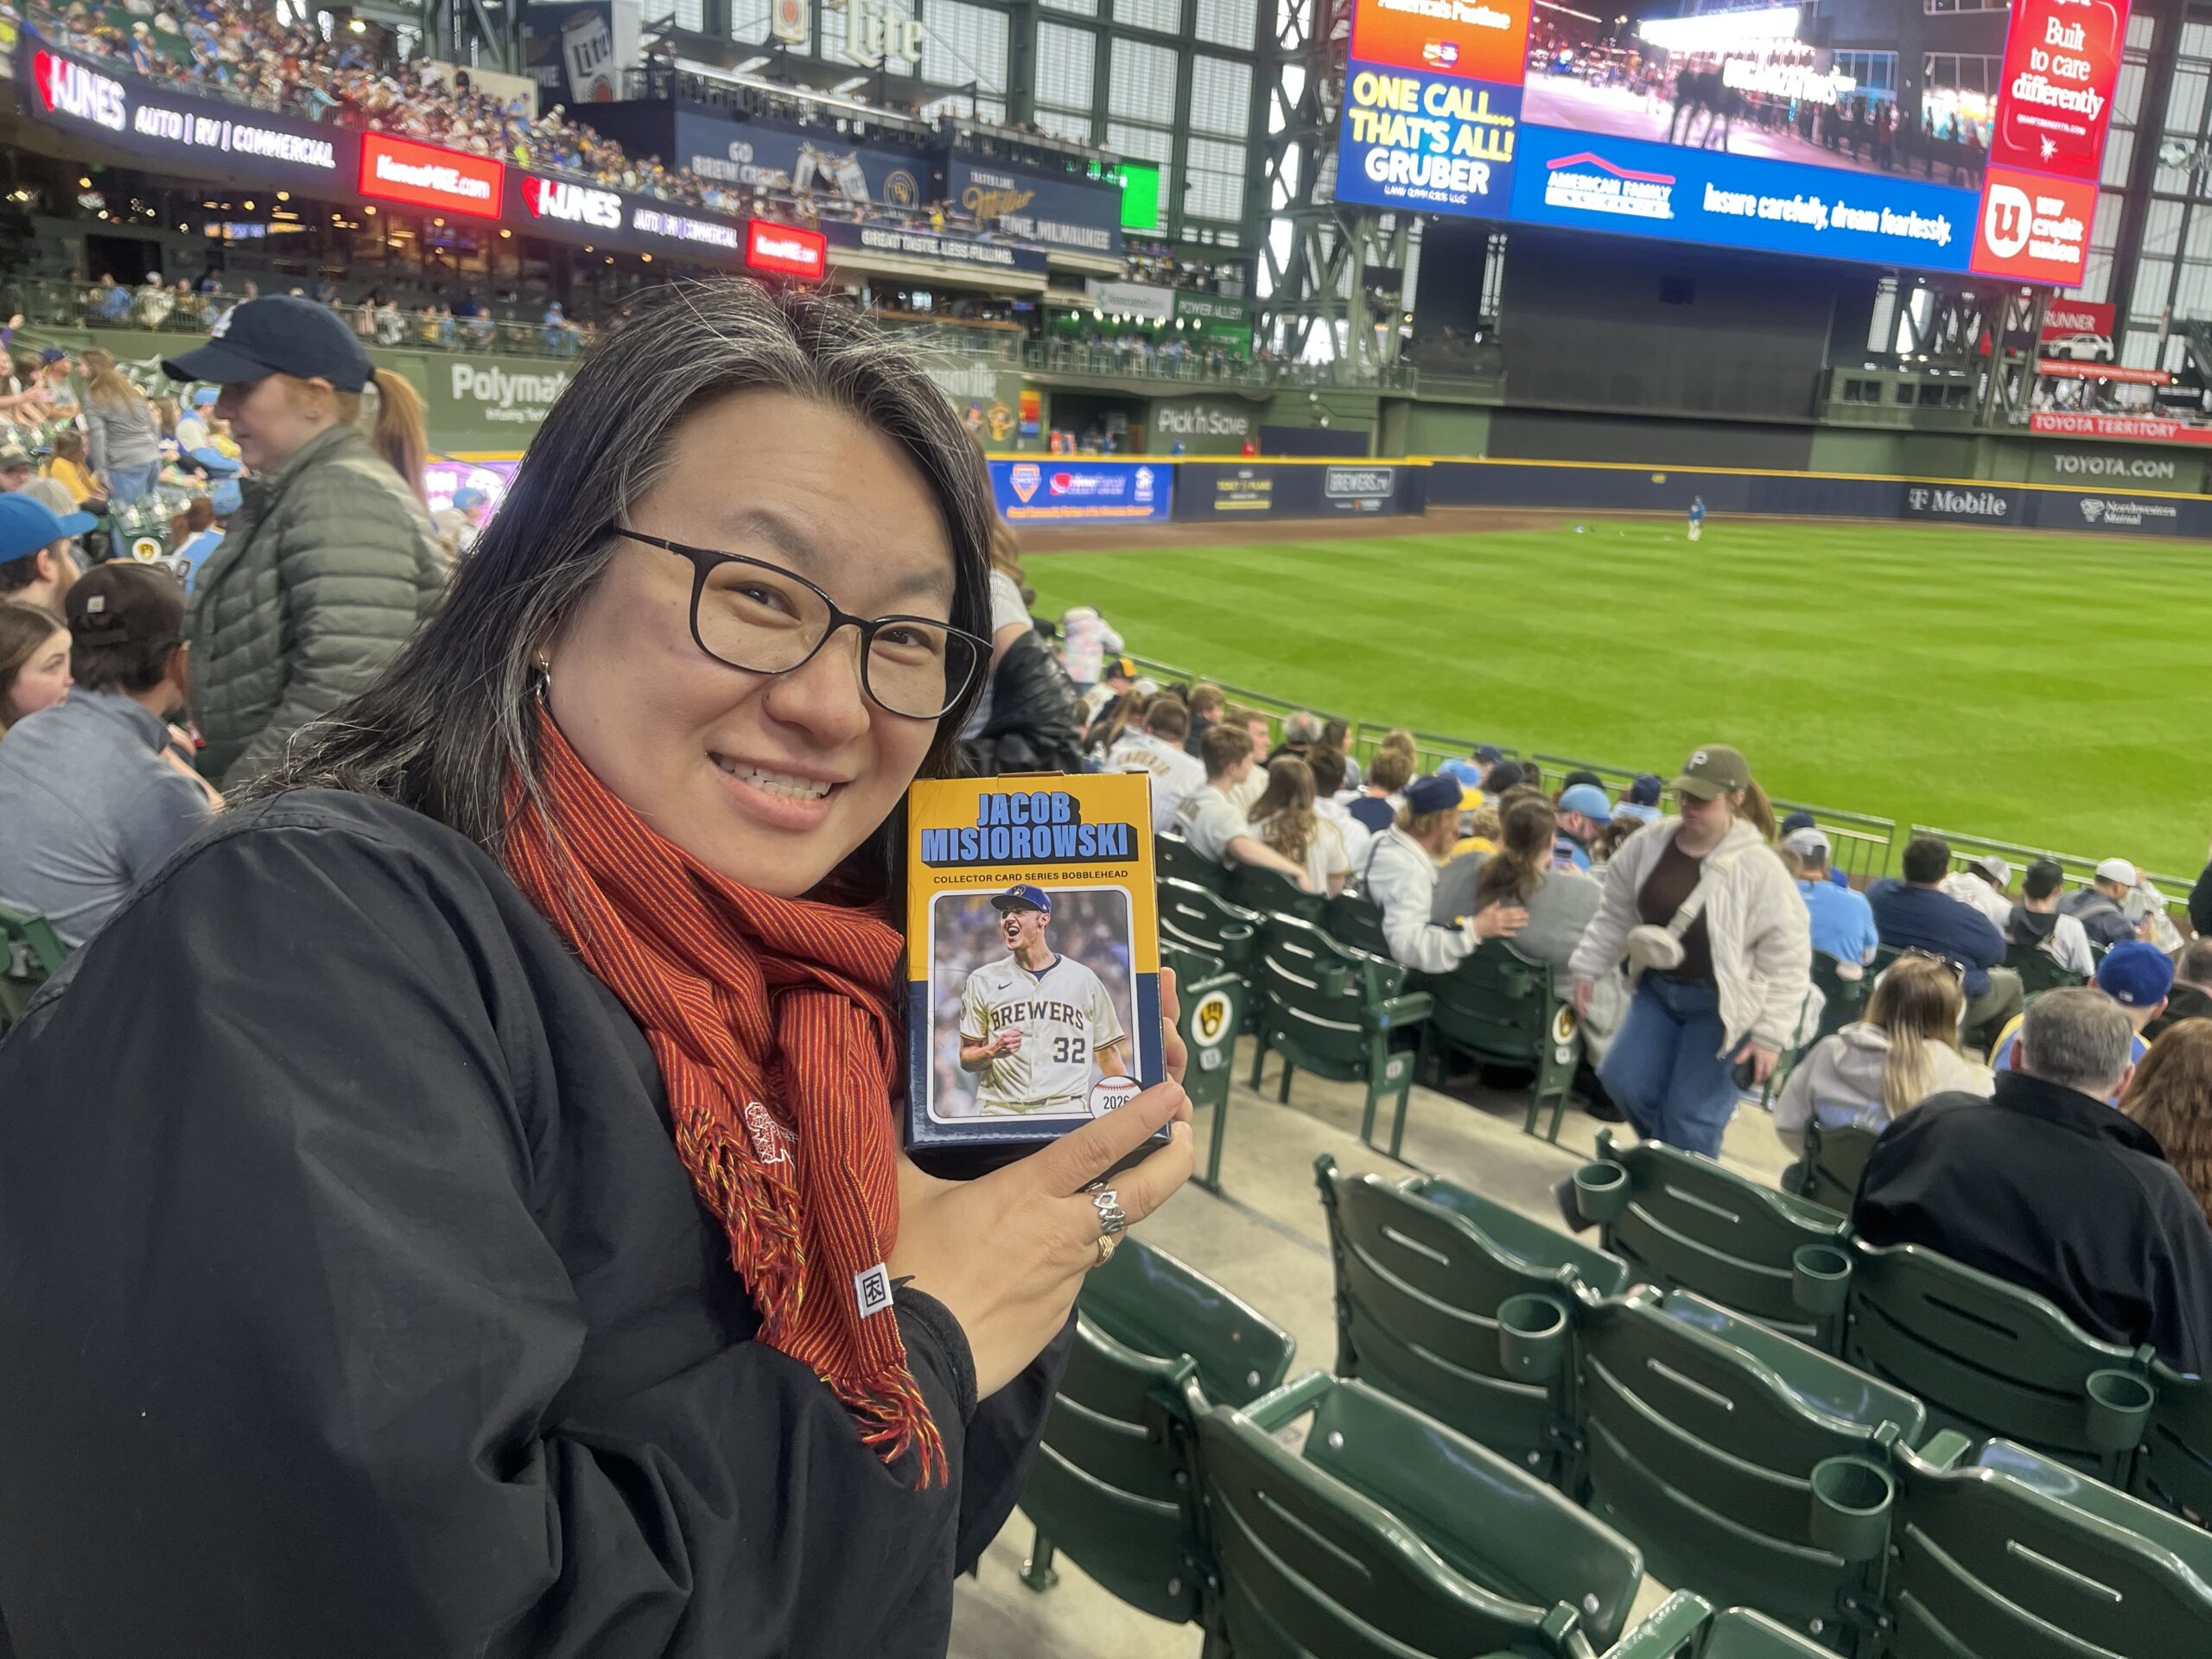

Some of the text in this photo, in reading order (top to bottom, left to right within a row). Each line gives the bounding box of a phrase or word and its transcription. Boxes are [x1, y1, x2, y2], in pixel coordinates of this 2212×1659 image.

[2044, 16, 2086, 52] Built
[2031, 47, 2091, 81] to care
[50, 54, 126, 130] KUNES
[1352, 72, 1421, 113] ONE
[2012, 72, 2105, 121] differently
[135, 105, 336, 168] AUTO RV COMMERCIAL
[728, 141, 753, 162] GO
[1349, 108, 1516, 162] THAT'S ALL!
[1364, 147, 1491, 194] GRUBER
[539, 178, 622, 229] KUNES
[1703, 182, 1758, 217] Insure
[1758, 194, 1829, 231] carefully,
[1830, 200, 1880, 232] dream
[861, 228, 901, 250] GREAT
[941, 240, 969, 257] LESS
[2031, 217, 2084, 242] credit
[2028, 238, 2081, 264] union
[1178, 300, 1211, 315] POWER
[451, 363, 572, 408] Polymat
[1208, 411, 1249, 435] Save
[2036, 415, 2177, 437] TOYOTA TERRITORY
[2053, 454, 2176, 480] TOYOTA.COM
[1931, 489, 2007, 516] Mobile
[976, 791, 1076, 827] JACOB
[921, 823, 1132, 863] MISIOROWSKI
[933, 870, 1128, 884] COLLECTOR CARD SERIES BOBBLEHEAD
[990, 1001, 1084, 1031] BREWERS
[1053, 1037, 1085, 1064] 32
